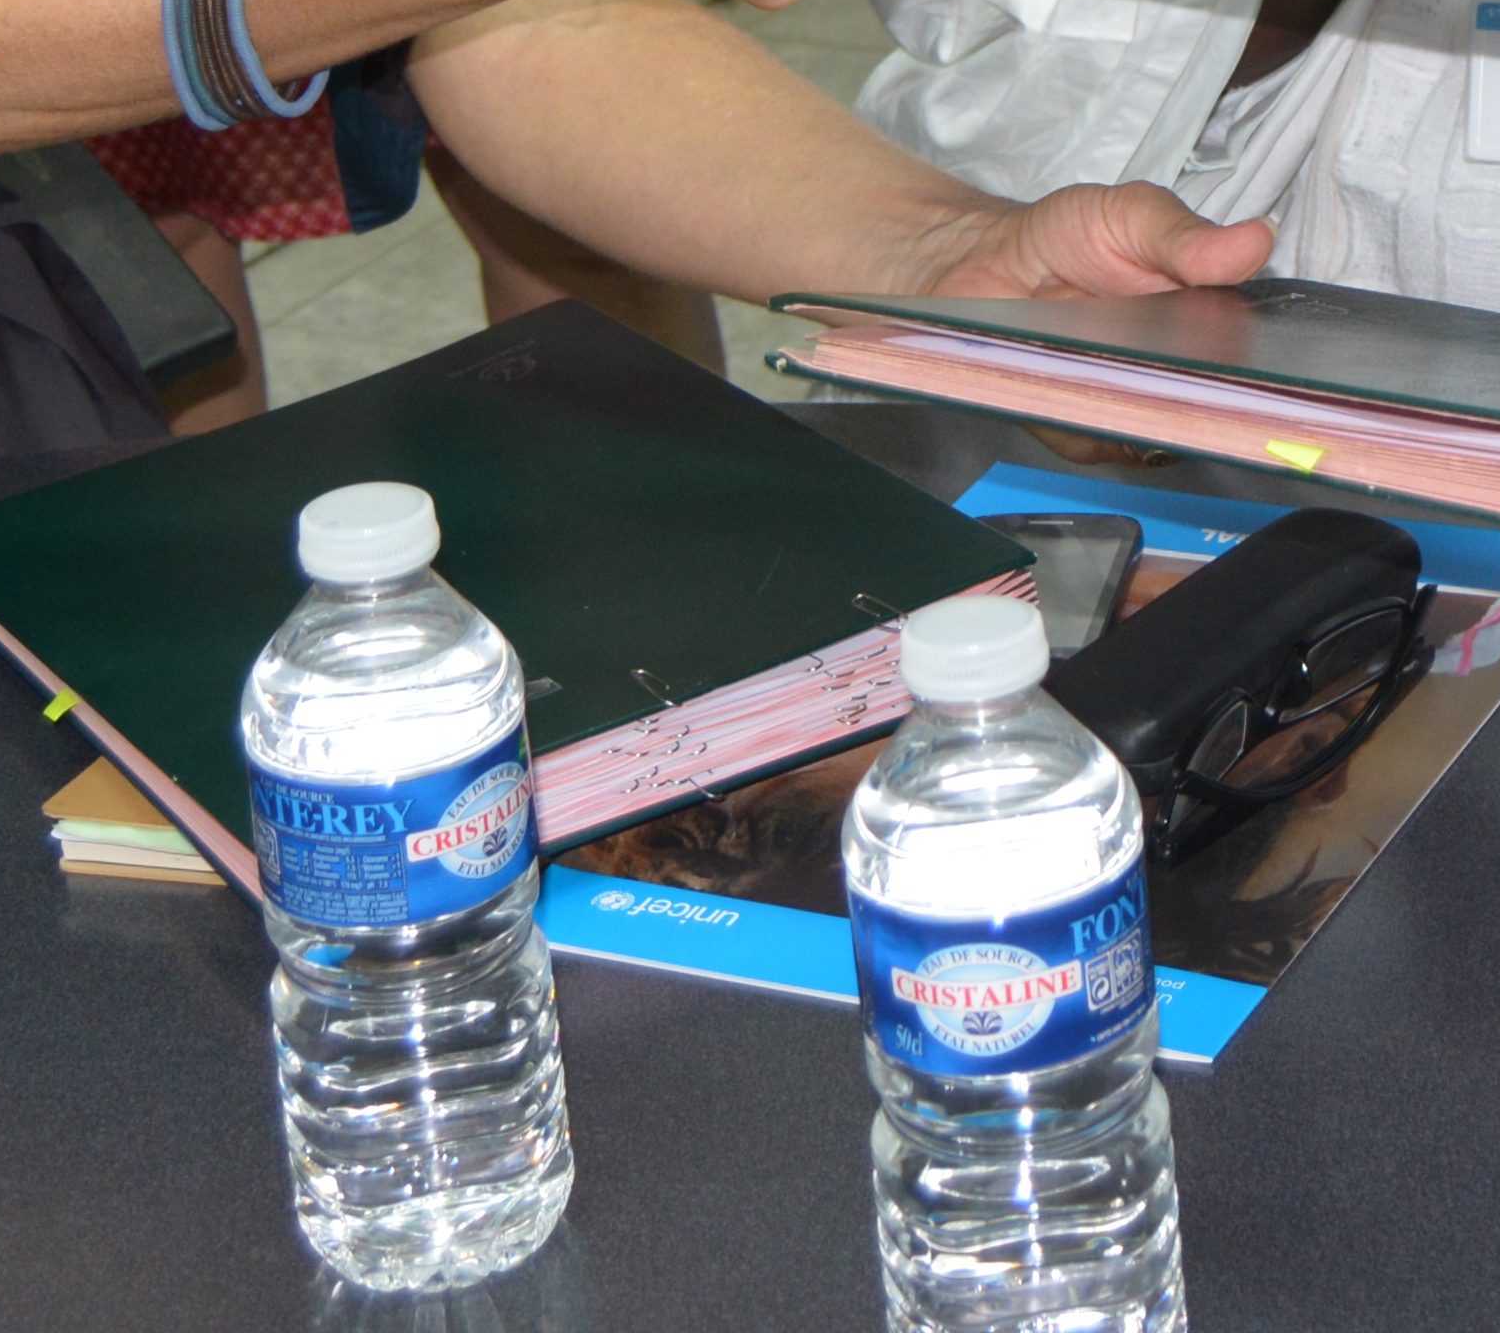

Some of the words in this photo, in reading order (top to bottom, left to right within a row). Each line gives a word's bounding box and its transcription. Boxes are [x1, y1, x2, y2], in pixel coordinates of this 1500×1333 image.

[253, 781, 415, 834] NTE-REY
[411, 773, 533, 857] CRISTALIN
[447, 791, 471, 820] EAU
[472, 778, 488, 797] DE
[626, 896, 740, 927] unicef
[922, 953, 948, 975] EAU
[950, 950, 970, 964] DE
[975, 948, 1040, 971] SOURCE
[895, 966, 1078, 1009] CRISTALINE
[933, 1024, 965, 1050] ETAT
[971, 1021, 1038, 1054] NATUREL
